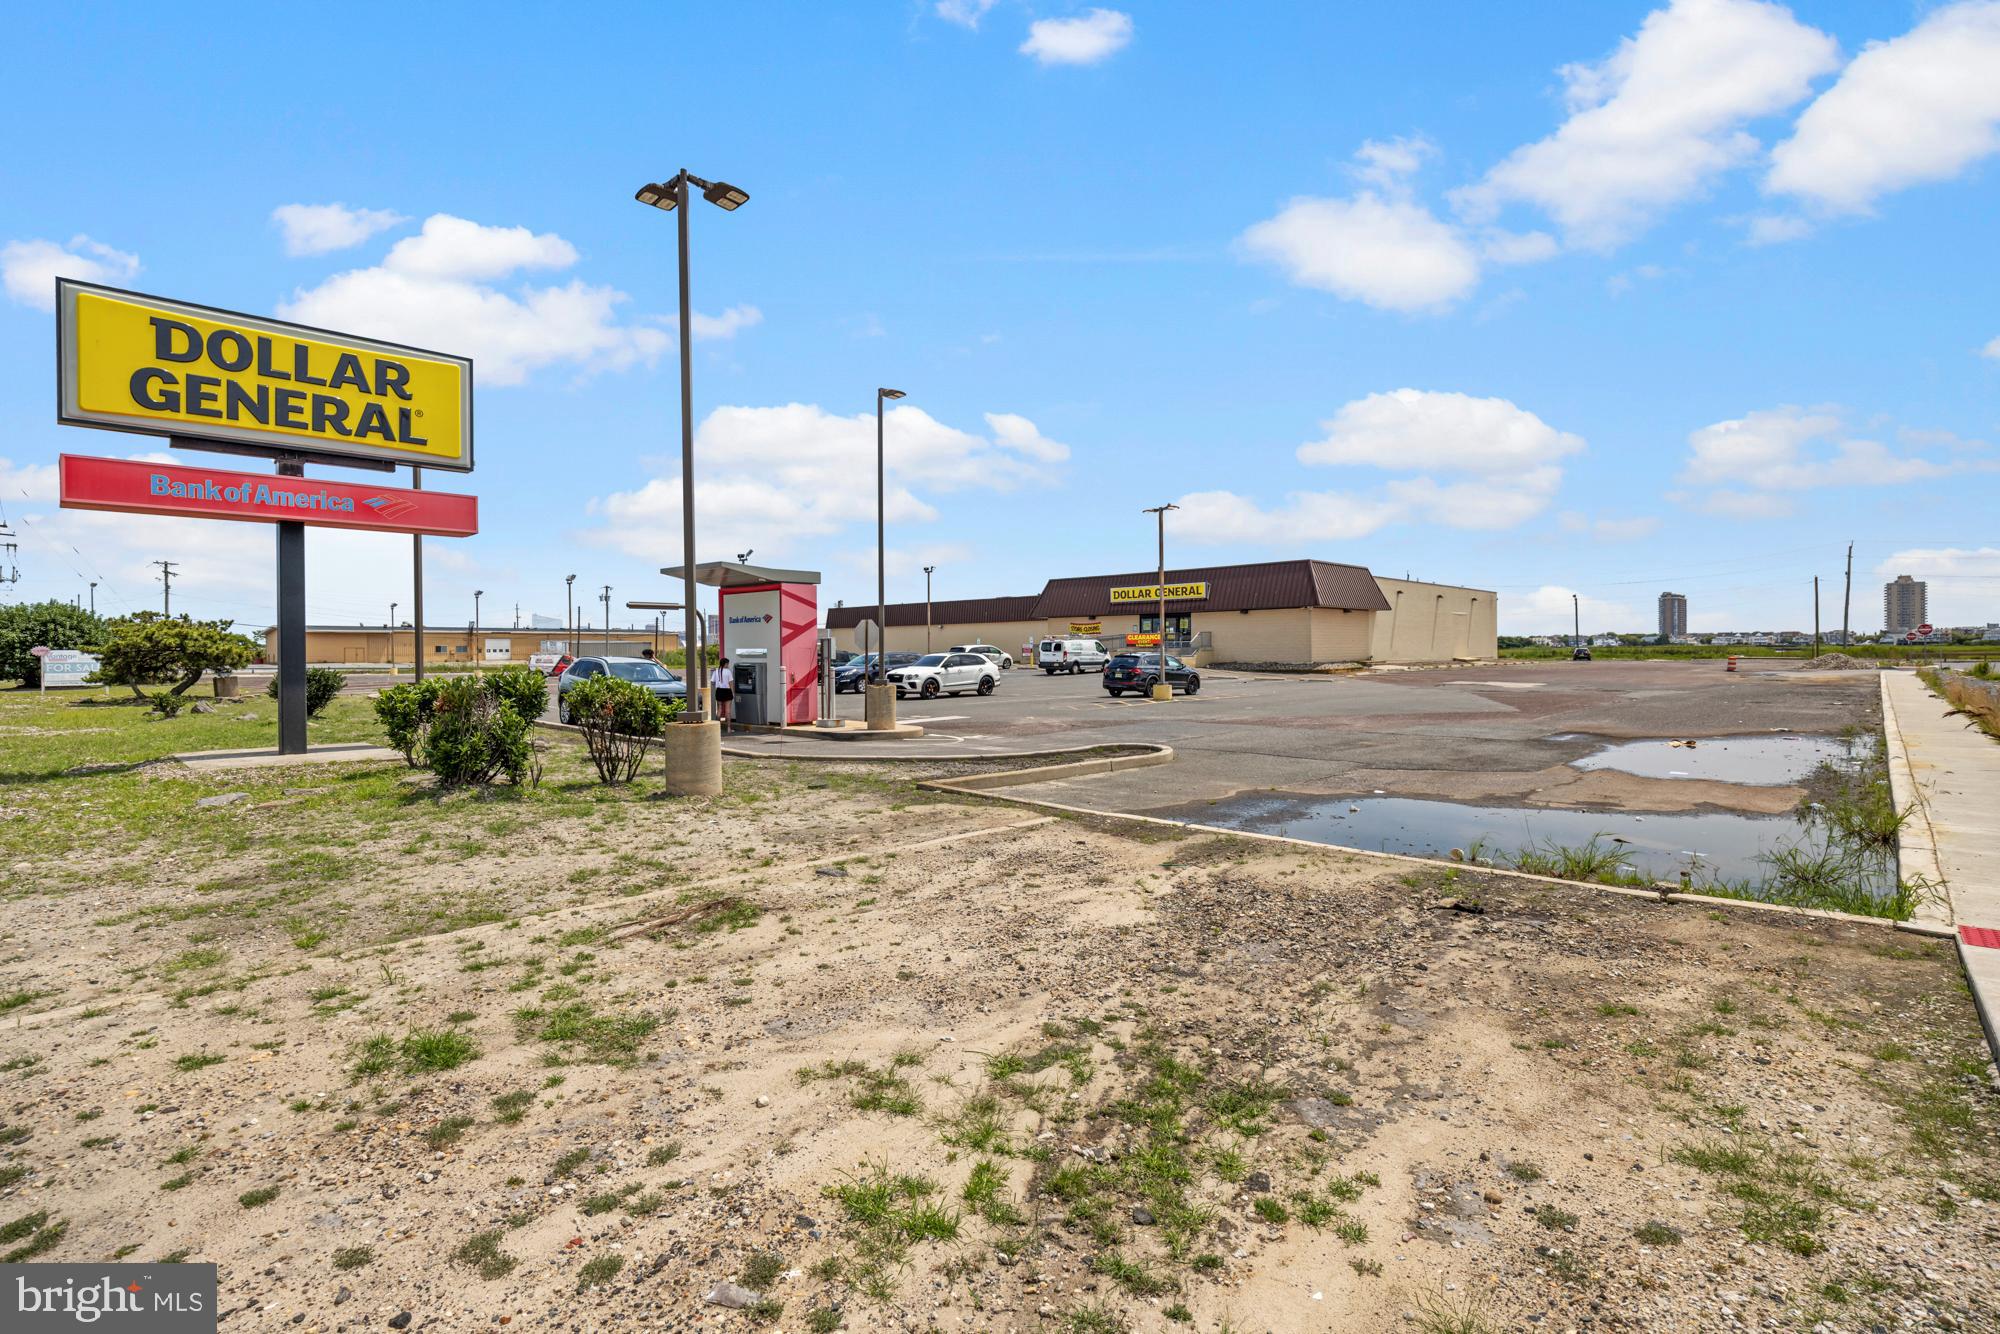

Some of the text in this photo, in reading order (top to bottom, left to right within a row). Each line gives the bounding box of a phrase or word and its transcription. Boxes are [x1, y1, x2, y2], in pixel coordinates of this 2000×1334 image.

[150, 316, 412, 400] DOLLAR
[129, 367, 427, 446] GENERAL
[151, 474, 354, 512] Bank of America
[1113, 585, 1202, 600] DOLLAR GENERAL
[729, 616, 740, 624] Bank
[46, 663, 100, 673] FOR SAL
